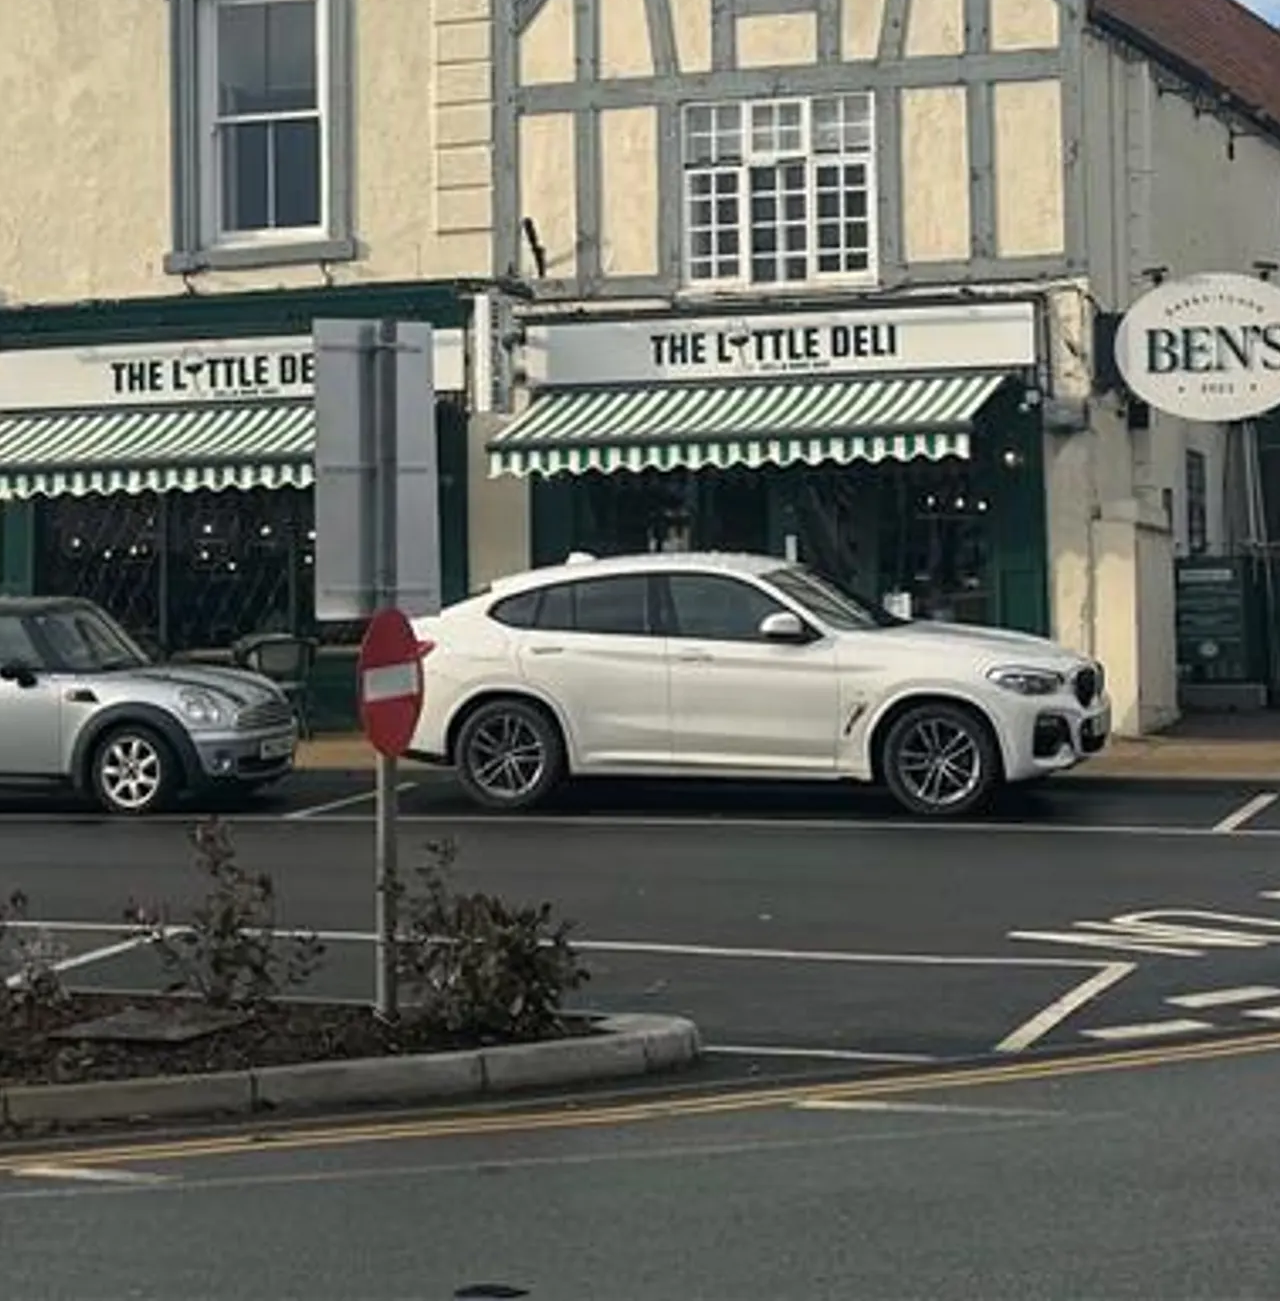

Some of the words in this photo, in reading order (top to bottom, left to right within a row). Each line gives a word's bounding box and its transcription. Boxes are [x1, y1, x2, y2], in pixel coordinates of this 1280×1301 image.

[650, 332, 706, 366] THE
[831, 324, 897, 357] DELI
[111, 361, 163, 393] THE
[280, 352, 315, 386] DE
